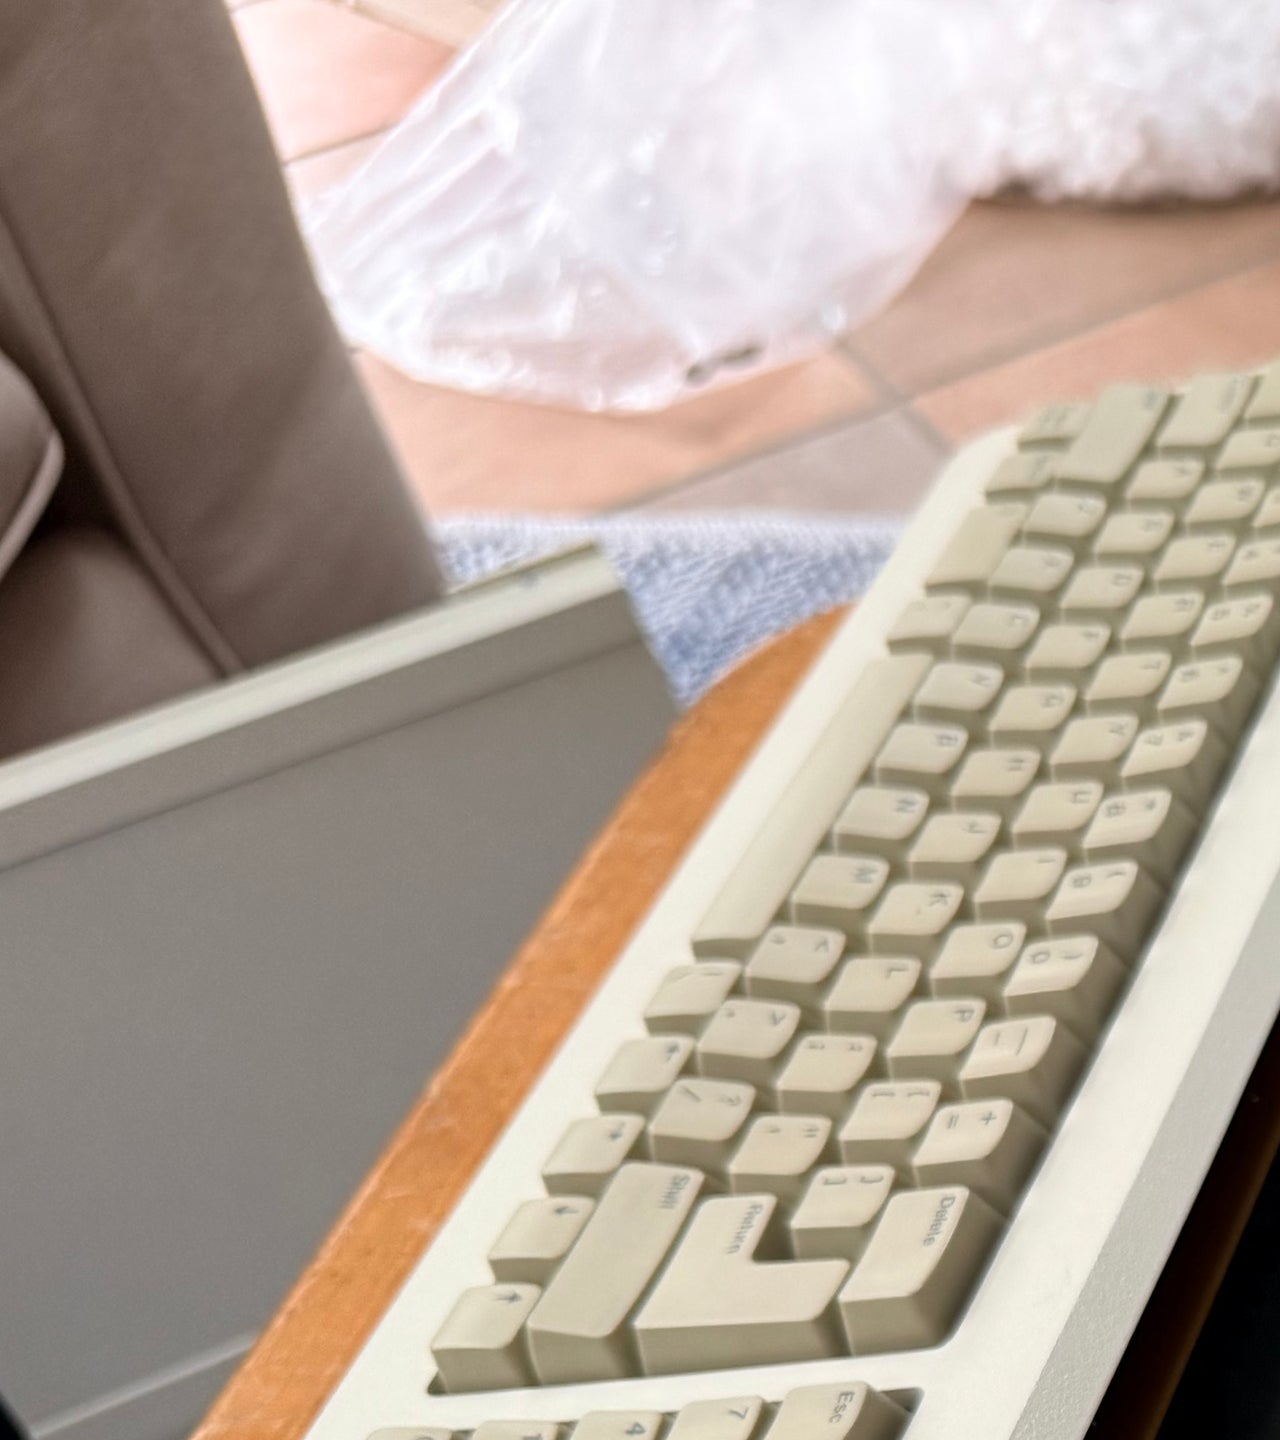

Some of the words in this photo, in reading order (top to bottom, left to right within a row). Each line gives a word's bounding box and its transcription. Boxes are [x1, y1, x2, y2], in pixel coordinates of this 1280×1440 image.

[927, 889, 952, 907] K
[991, 933, 1014, 950] O
[884, 966, 908, 979] L
[955, 1008, 976, 1025] P
[660, 1174, 691, 1210] Shift
[725, 1202, 764, 1255] Return
[922, 1194, 957, 1248] Delete
[728, 1406, 751, 1421] 7
[829, 1389, 855, 1424] Esc
[625, 1421, 646, 1437] 4
